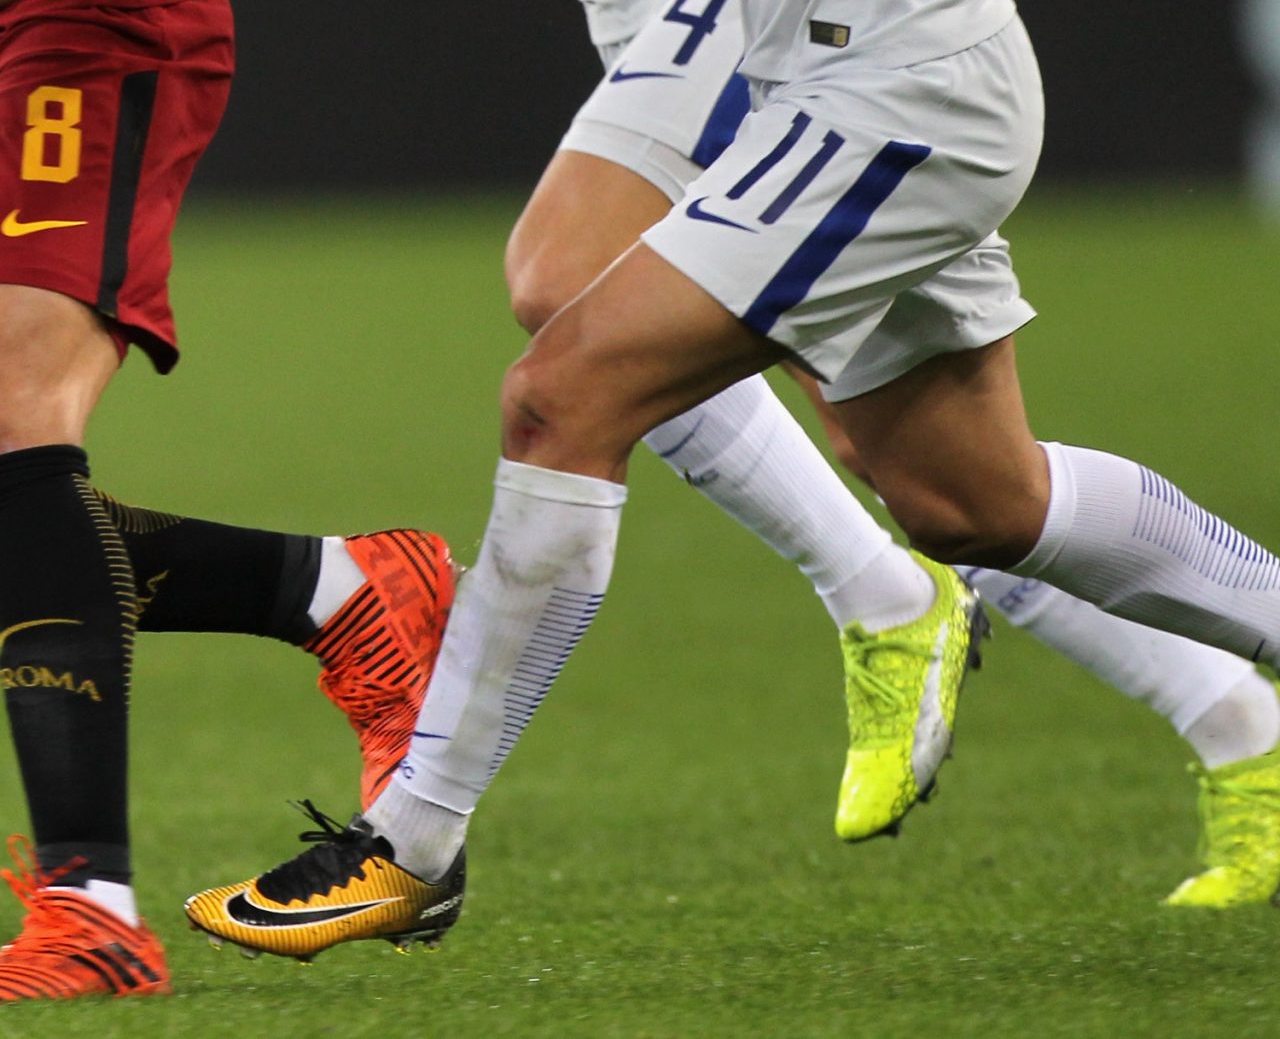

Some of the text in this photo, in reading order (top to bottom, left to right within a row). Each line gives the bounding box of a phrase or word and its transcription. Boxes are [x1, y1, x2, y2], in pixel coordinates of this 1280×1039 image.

[22, 85, 82, 183] 8
[725, 110, 846, 225] 11
[0, 665, 103, 702] ROMA
